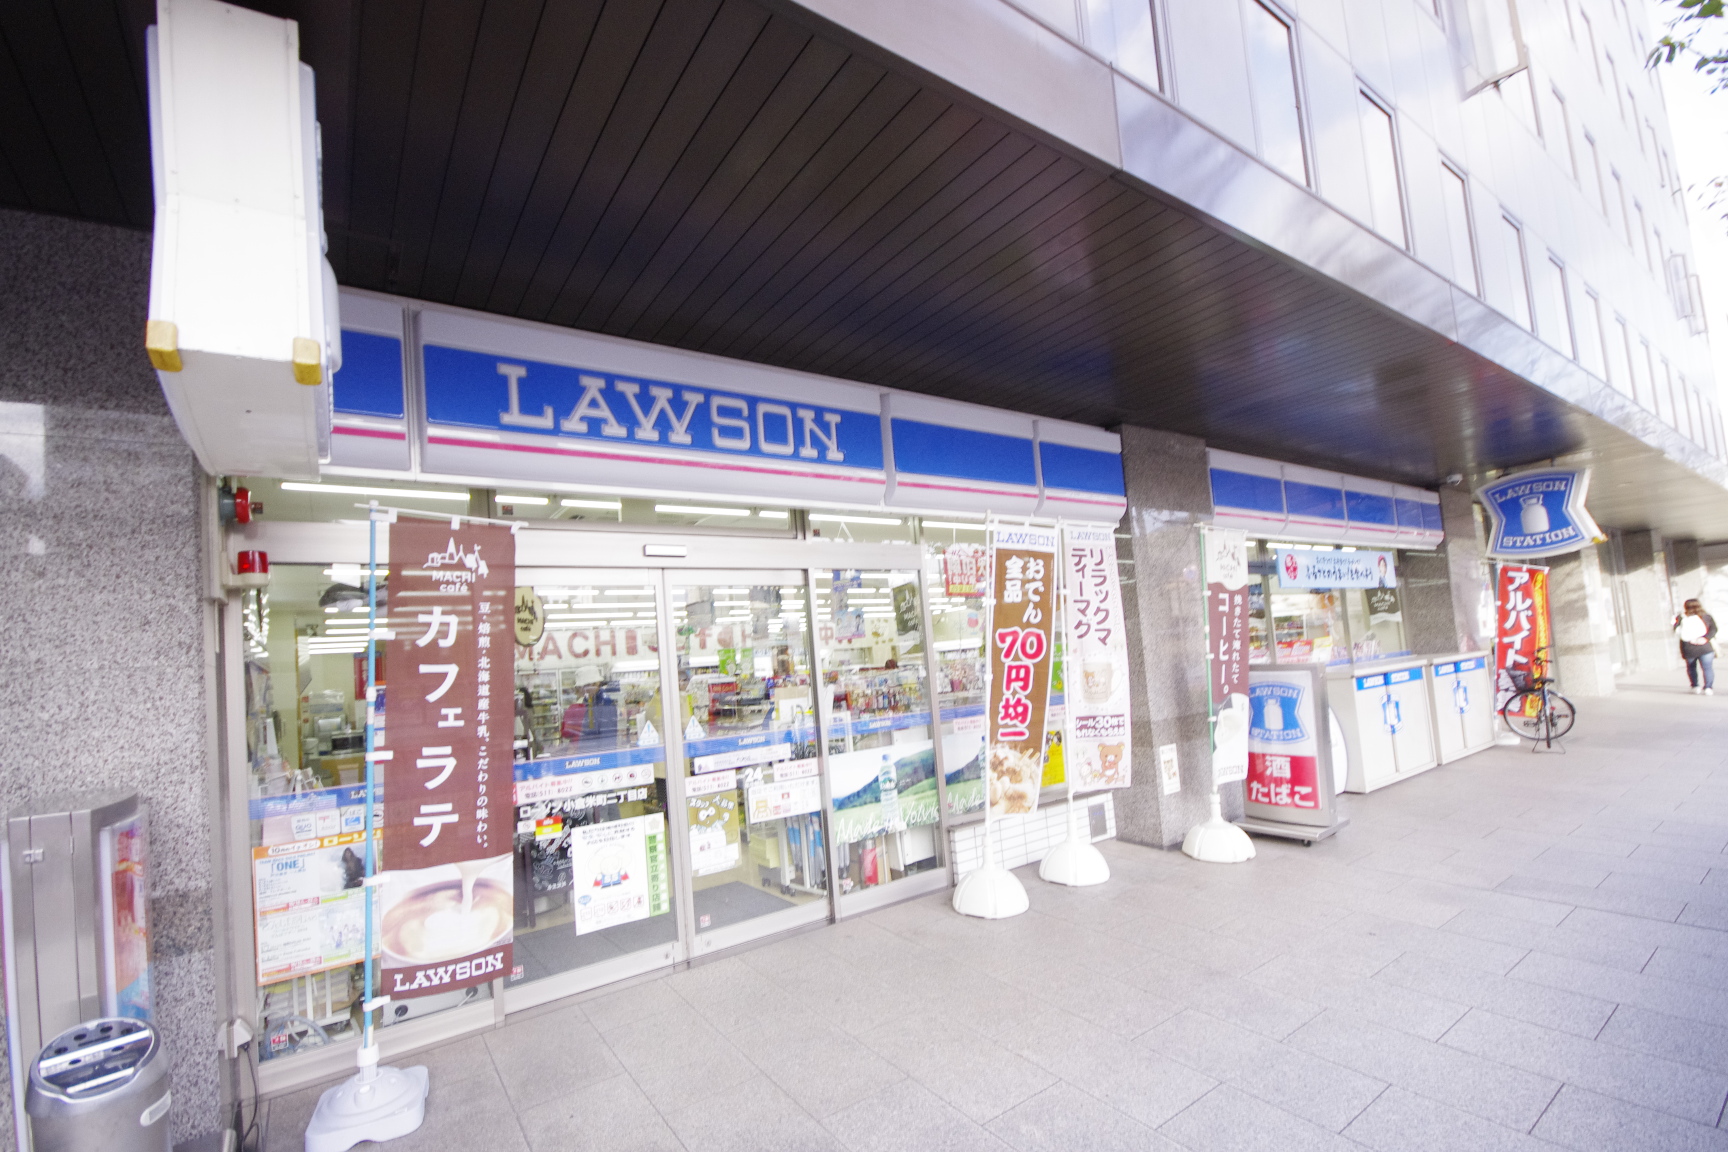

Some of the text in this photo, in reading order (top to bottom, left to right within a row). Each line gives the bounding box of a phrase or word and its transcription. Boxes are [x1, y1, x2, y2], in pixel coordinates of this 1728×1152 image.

[497, 363, 844, 462] LAWSON
[1494, 480, 1567, 503] LAWSON
[996, 531, 1056, 547] LAWSON
[1070, 531, 1111, 541] LAWSON
[1502, 525, 1576, 547] STATION
[431, 570, 476, 583] MACHI
[1003, 555, 1025, 604] 全品
[1023, 556, 1045, 624] おでん
[1072, 548, 1091, 639] ティーマグ
[1090, 548, 1111, 646] リラックマ
[413, 605, 465, 848] カフェラテ
[1251, 727, 1303, 740] STATION
[565, 757, 601, 769] LAWSON
[1265, 755, 1291, 779] 酒
[1250, 781, 1315, 807] たばこ
[393, 952, 504, 992] LAWSON
